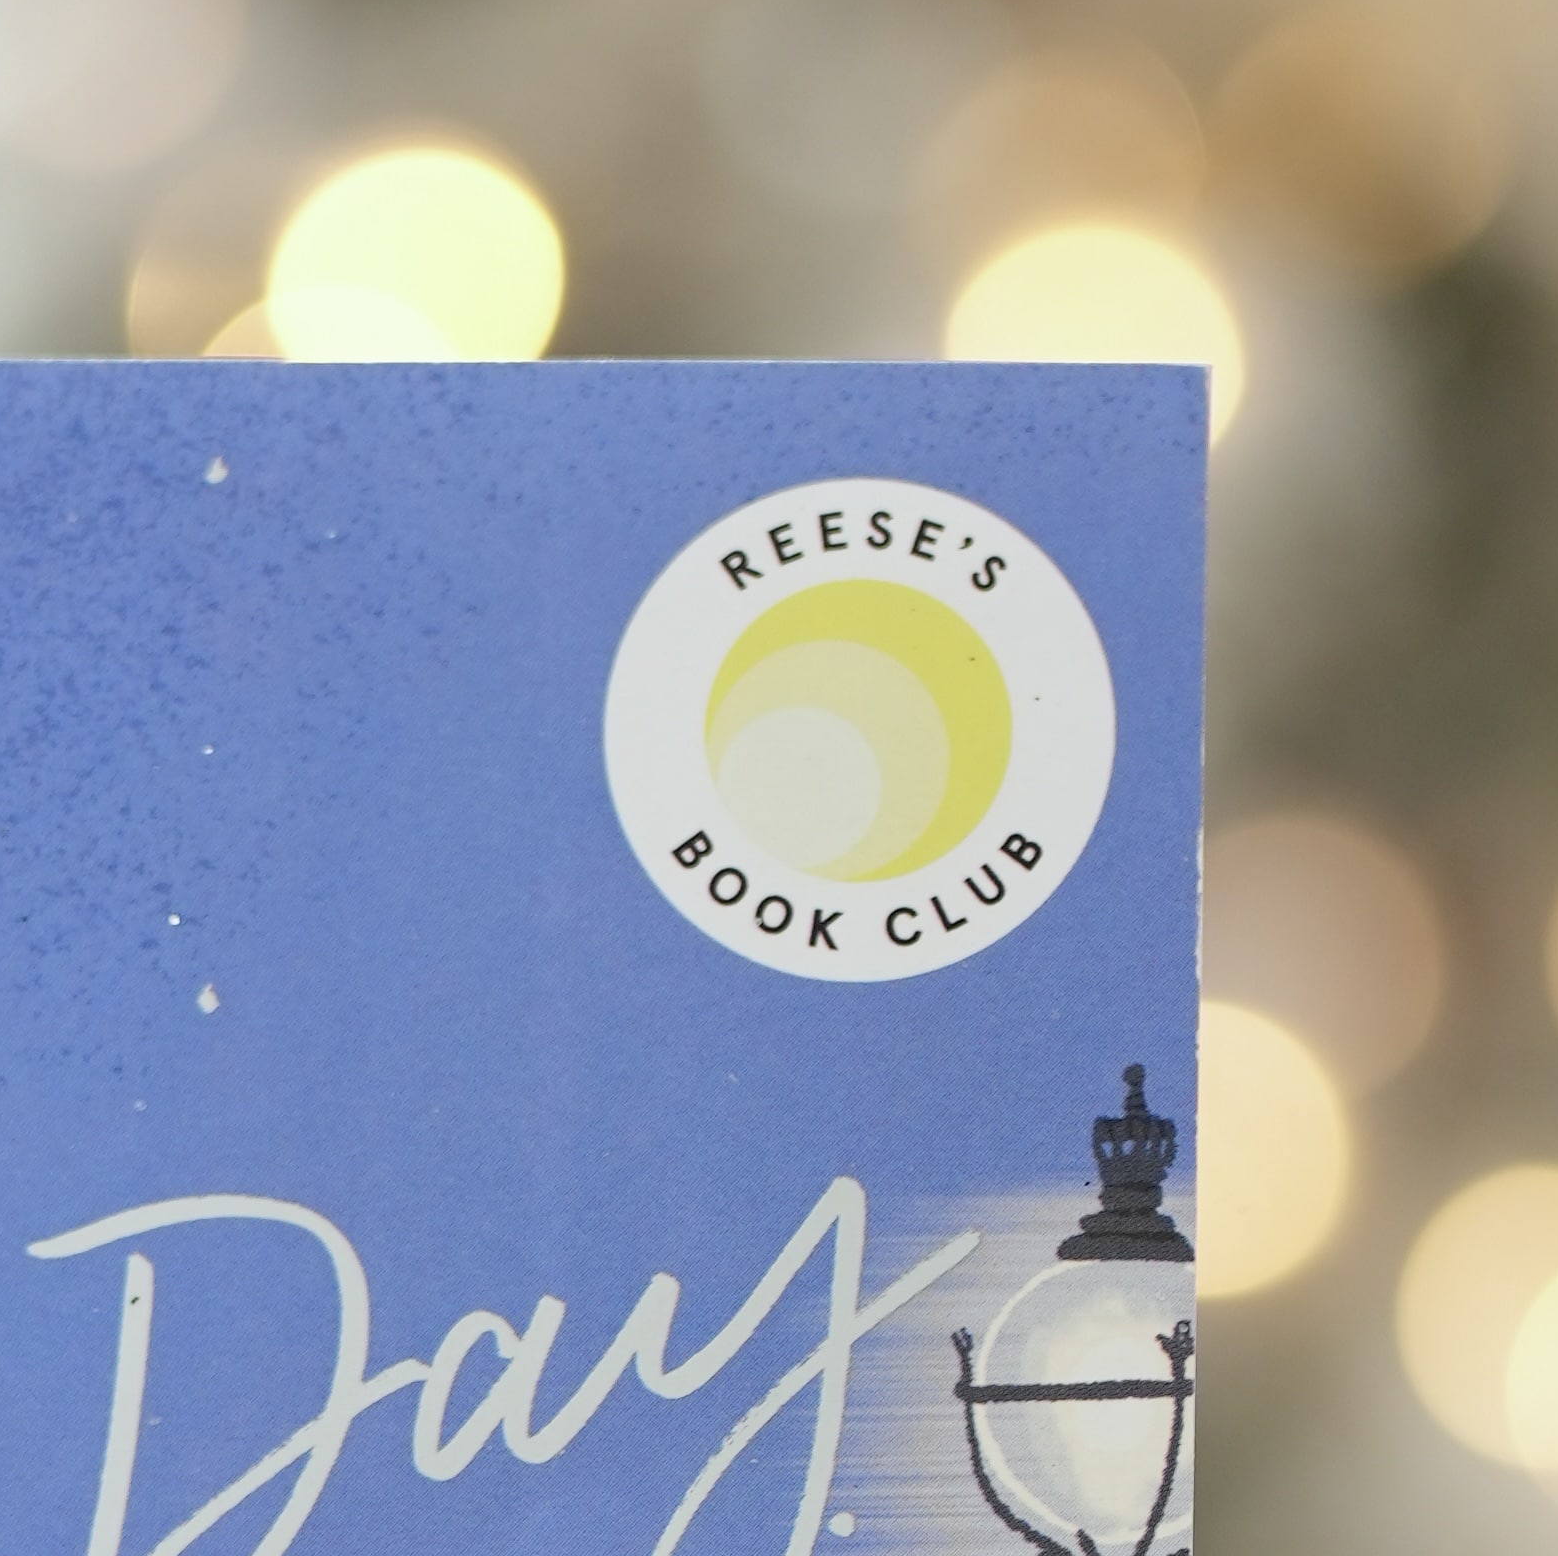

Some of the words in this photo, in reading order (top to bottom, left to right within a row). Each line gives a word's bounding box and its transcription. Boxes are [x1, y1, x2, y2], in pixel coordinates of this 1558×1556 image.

[720, 511, 1007, 592] REESE’S
[671, 830, 843, 951] BOOK
[885, 831, 1043, 946] CLUB
